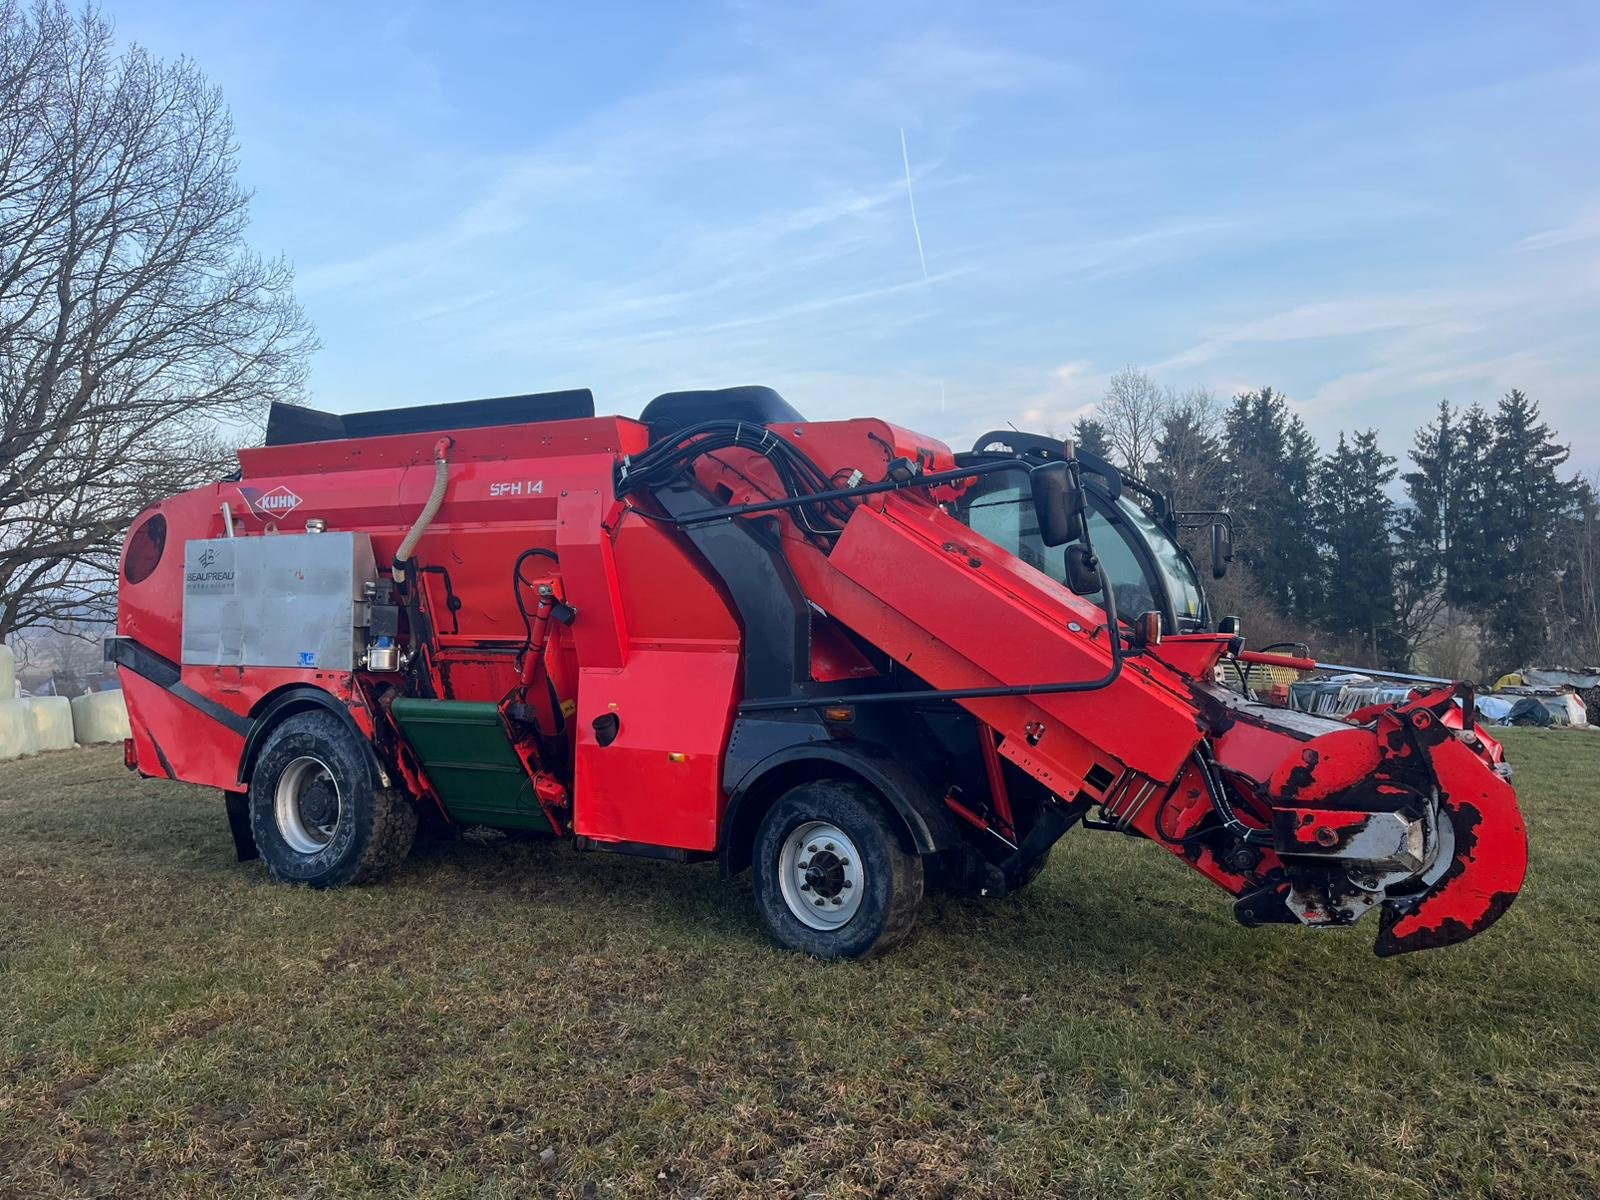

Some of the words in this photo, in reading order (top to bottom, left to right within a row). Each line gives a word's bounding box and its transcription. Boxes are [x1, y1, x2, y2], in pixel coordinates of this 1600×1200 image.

[489, 481, 522, 496] SPH
[527, 479, 543, 494] 14
[262, 495, 296, 509] KUHN
[186, 571, 235, 581] BEAUPREAU
